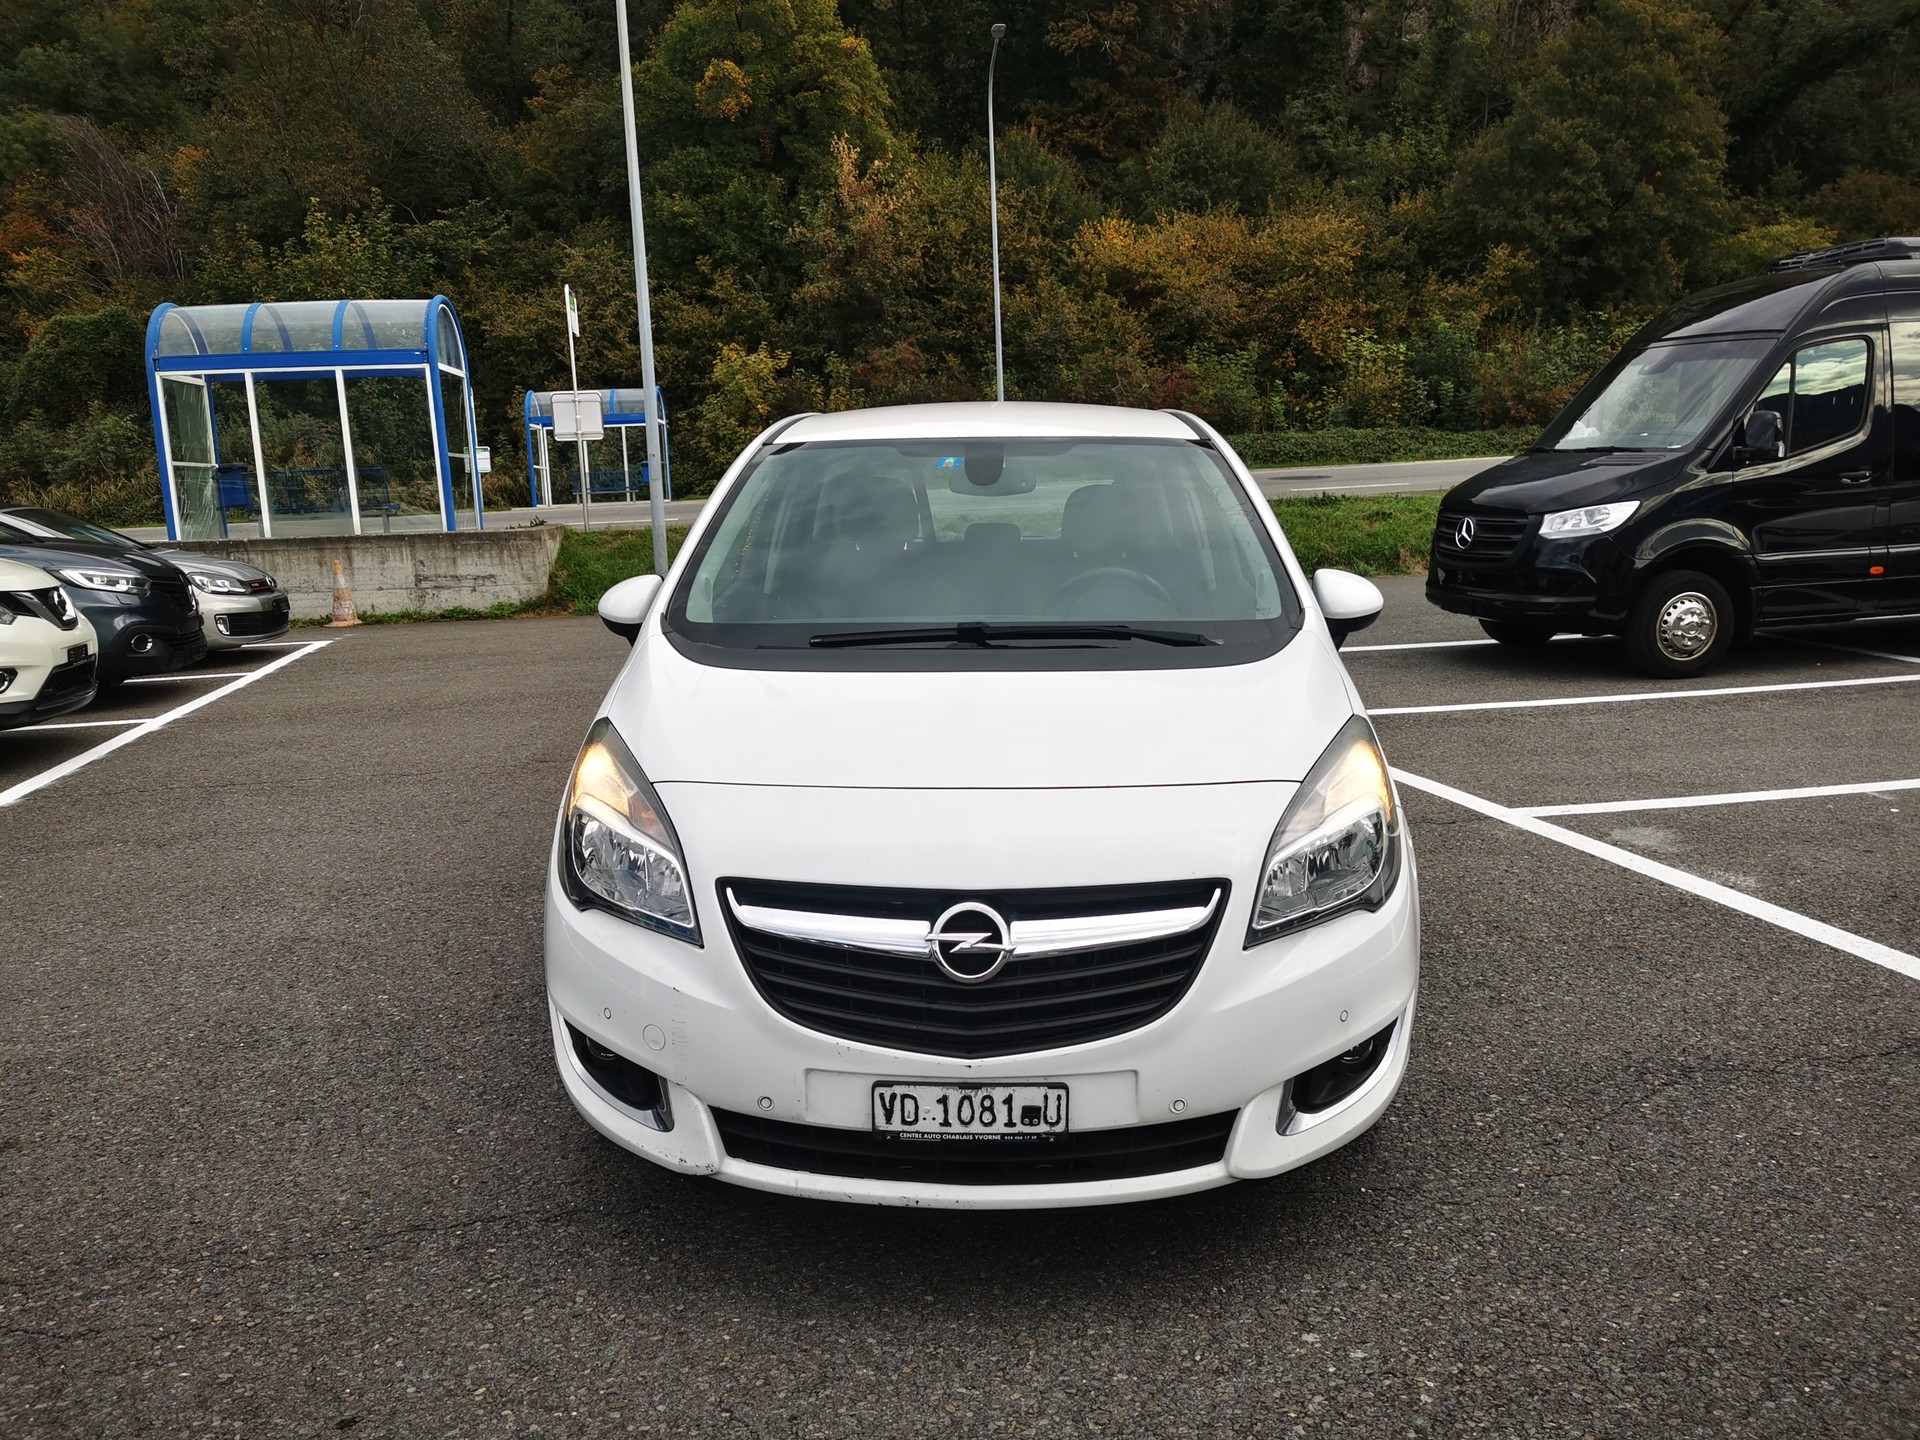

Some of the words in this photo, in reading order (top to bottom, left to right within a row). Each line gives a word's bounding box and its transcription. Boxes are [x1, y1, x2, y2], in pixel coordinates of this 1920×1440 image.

[879, 1092, 919, 1126] VD
[936, 1092, 1017, 1127] 1081
[1043, 1092, 1062, 1127] U
